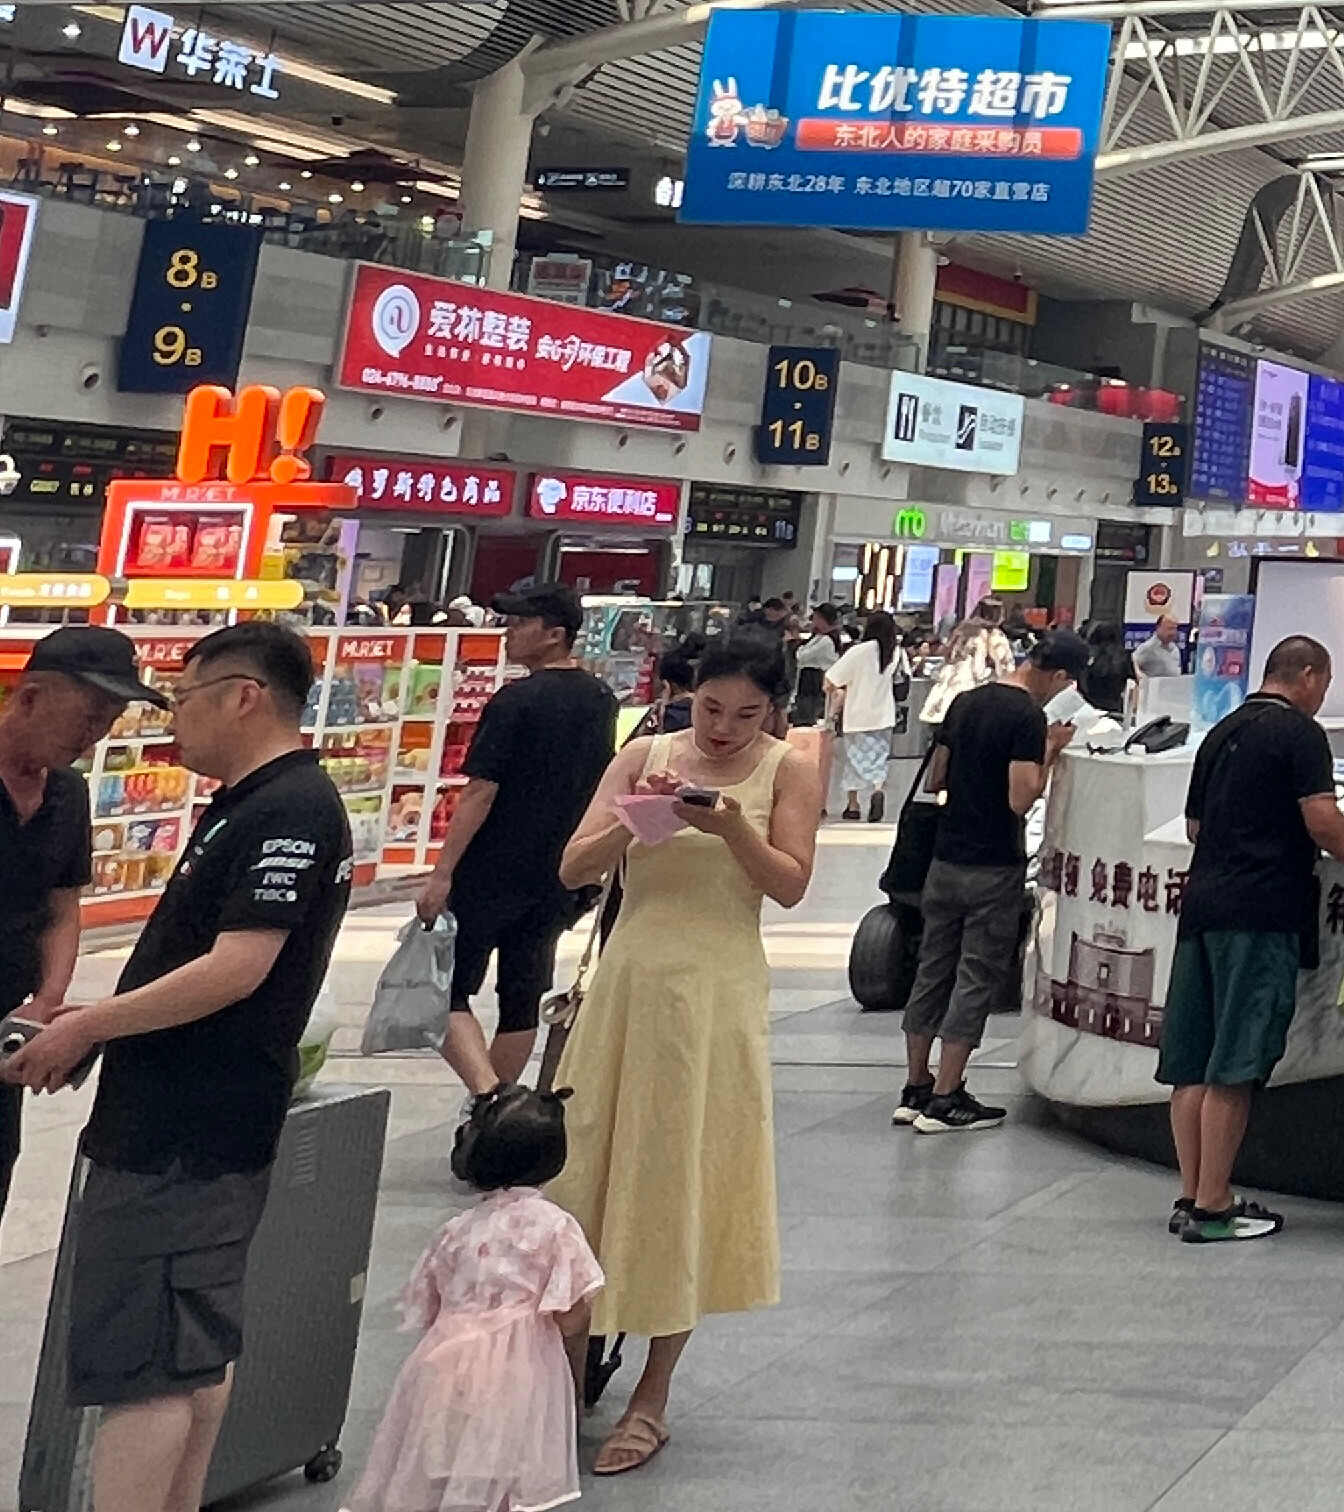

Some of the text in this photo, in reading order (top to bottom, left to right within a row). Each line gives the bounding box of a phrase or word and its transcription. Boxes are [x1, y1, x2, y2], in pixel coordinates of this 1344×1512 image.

[129, 17, 281, 100] W 华莱士
[818, 65, 1072, 120] 比优特超市
[833, 125, 1043, 155] 东北人的家庭采购员
[727, 171, 1050, 203] 深耕东北28年 东北地区超70家直营店
[165, 249, 218, 290] 8B
[152, 326, 202, 367] 9B
[774, 360, 829, 391] 10B
[768, 419, 820, 451] 11B
[570, 486, 658, 516] 京东便利店
[261, 838, 316, 856] EPSON
[1088, 856, 1191, 916] 免费电话
